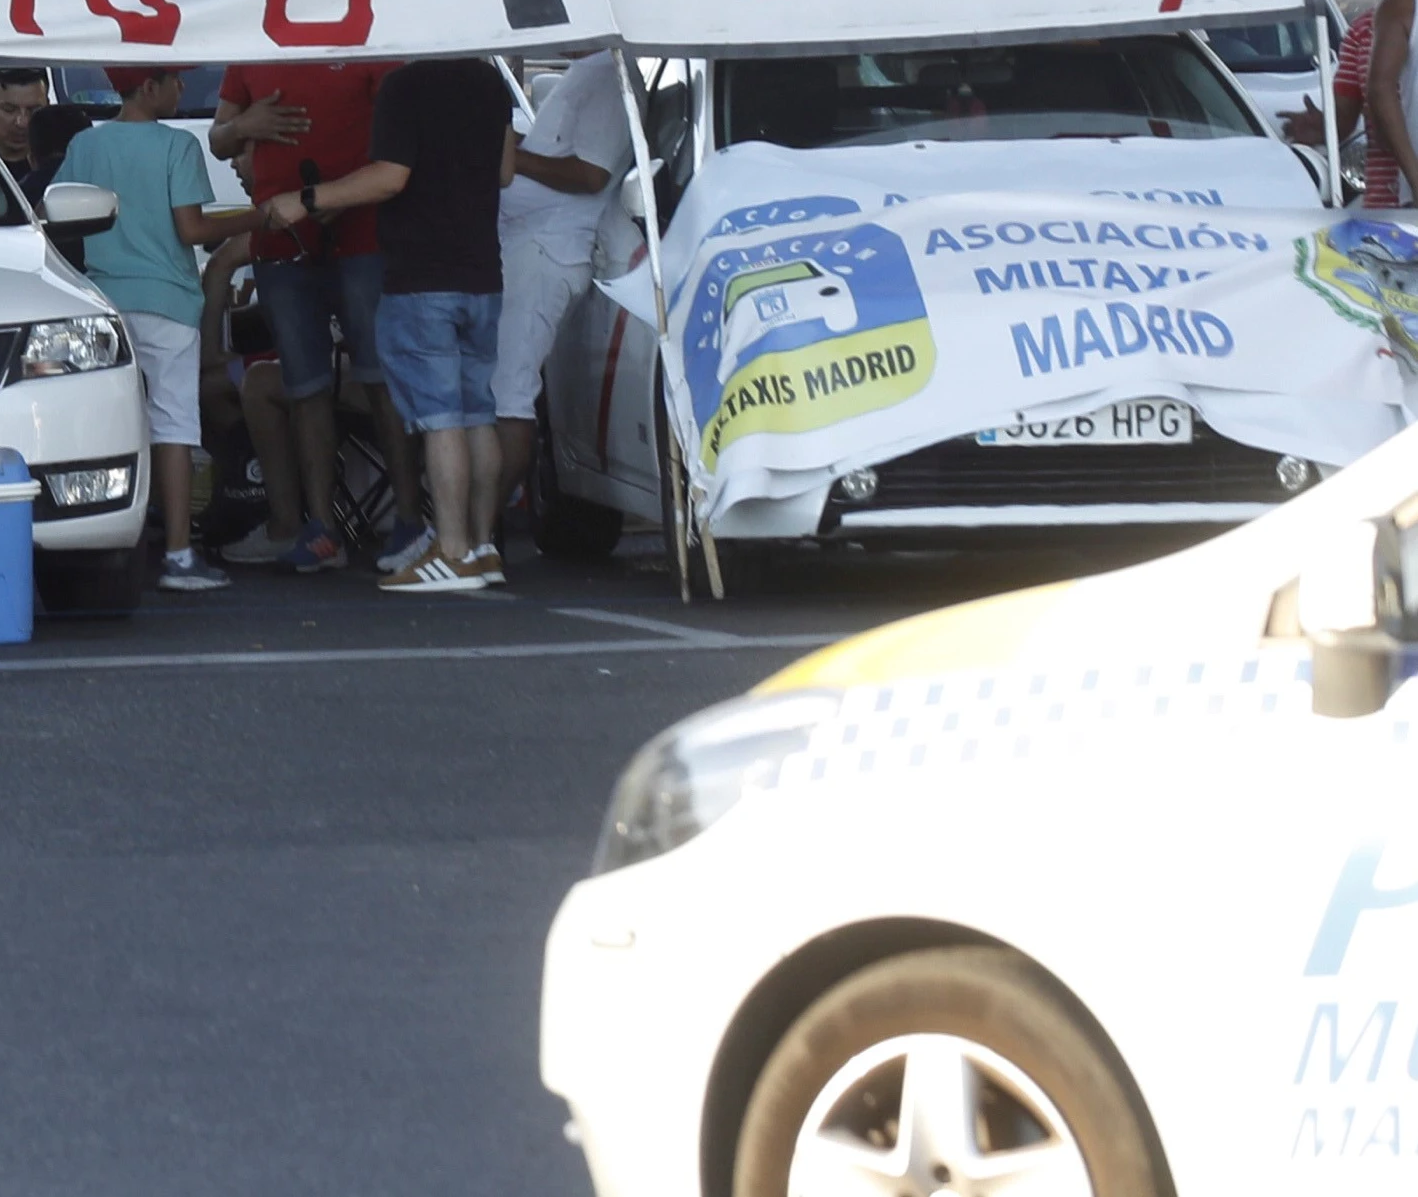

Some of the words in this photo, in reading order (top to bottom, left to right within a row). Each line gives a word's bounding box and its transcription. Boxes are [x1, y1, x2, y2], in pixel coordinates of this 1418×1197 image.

[925, 220, 1269, 255] ASOCIACIÓN
[1010, 302, 1234, 378] MADRID
[803, 344, 916, 401] MADRID
[1113, 404, 1179, 436] HPG
